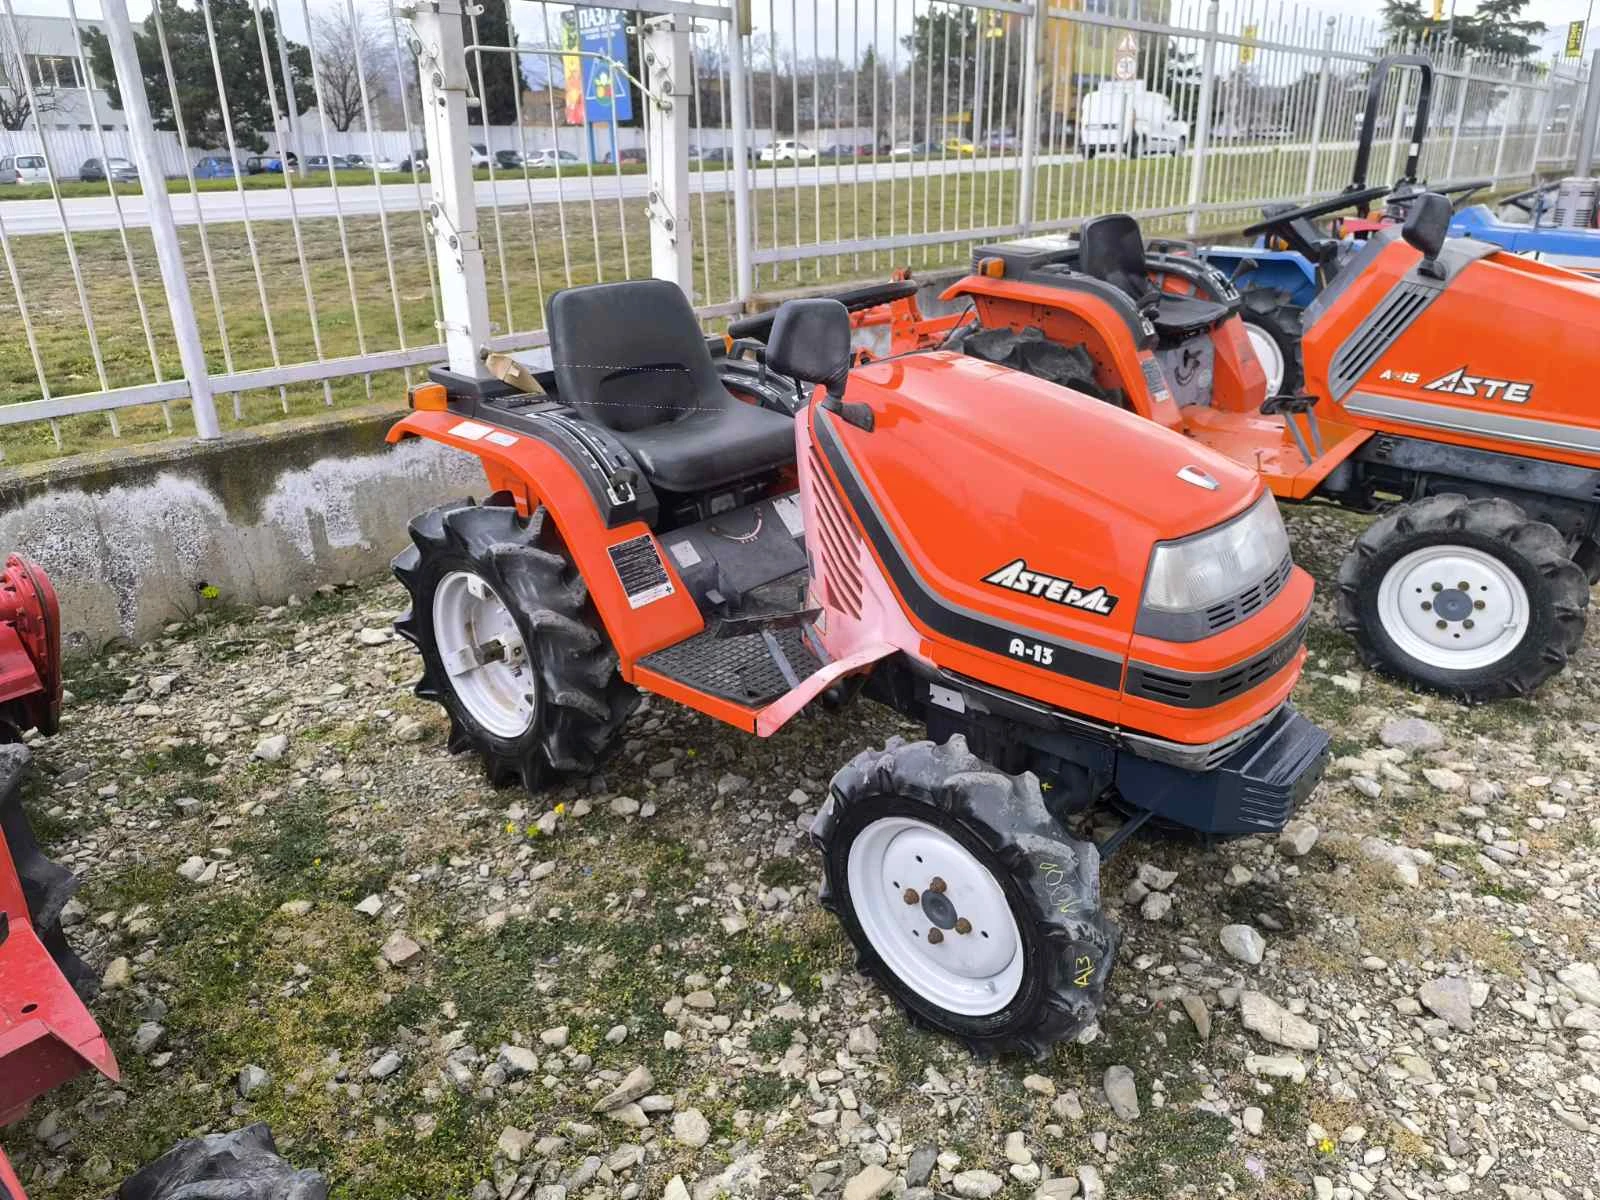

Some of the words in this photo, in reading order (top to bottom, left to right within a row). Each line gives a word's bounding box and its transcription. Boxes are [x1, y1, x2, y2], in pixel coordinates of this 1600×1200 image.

[1421, 365, 1533, 403] ASTE
[981, 559, 1117, 615] ASTEPAL
[1008, 638, 1054, 665] A-13
